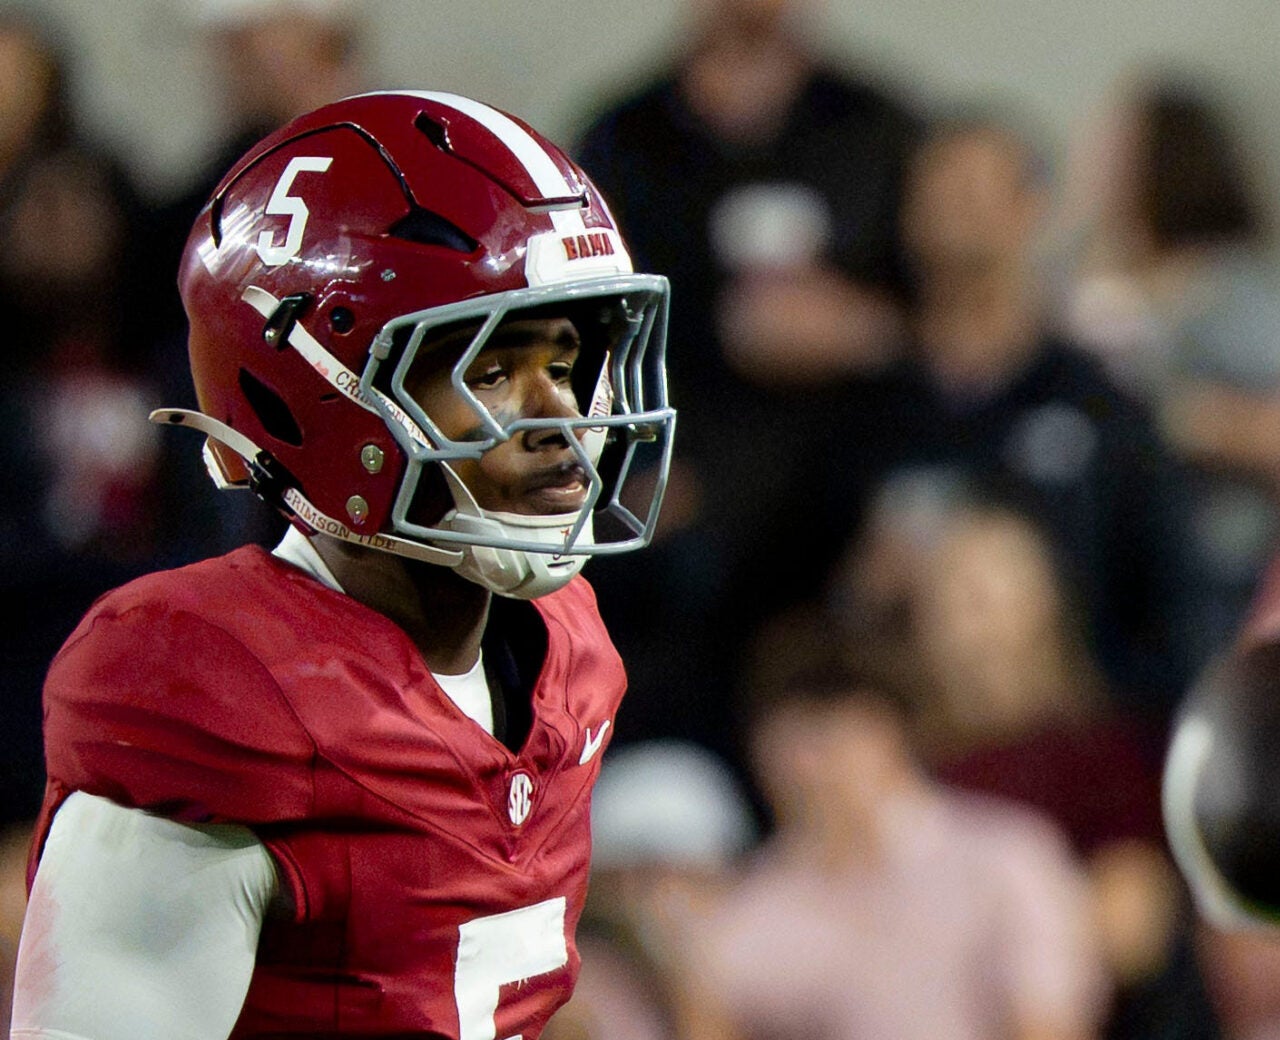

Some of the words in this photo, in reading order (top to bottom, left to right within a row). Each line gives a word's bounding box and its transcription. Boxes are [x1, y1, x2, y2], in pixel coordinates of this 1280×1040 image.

[256, 156, 334, 267] 5
[561, 232, 615, 261] BAMA
[284, 488, 350, 539] CRIMSON
[508, 772, 534, 826] SEC
